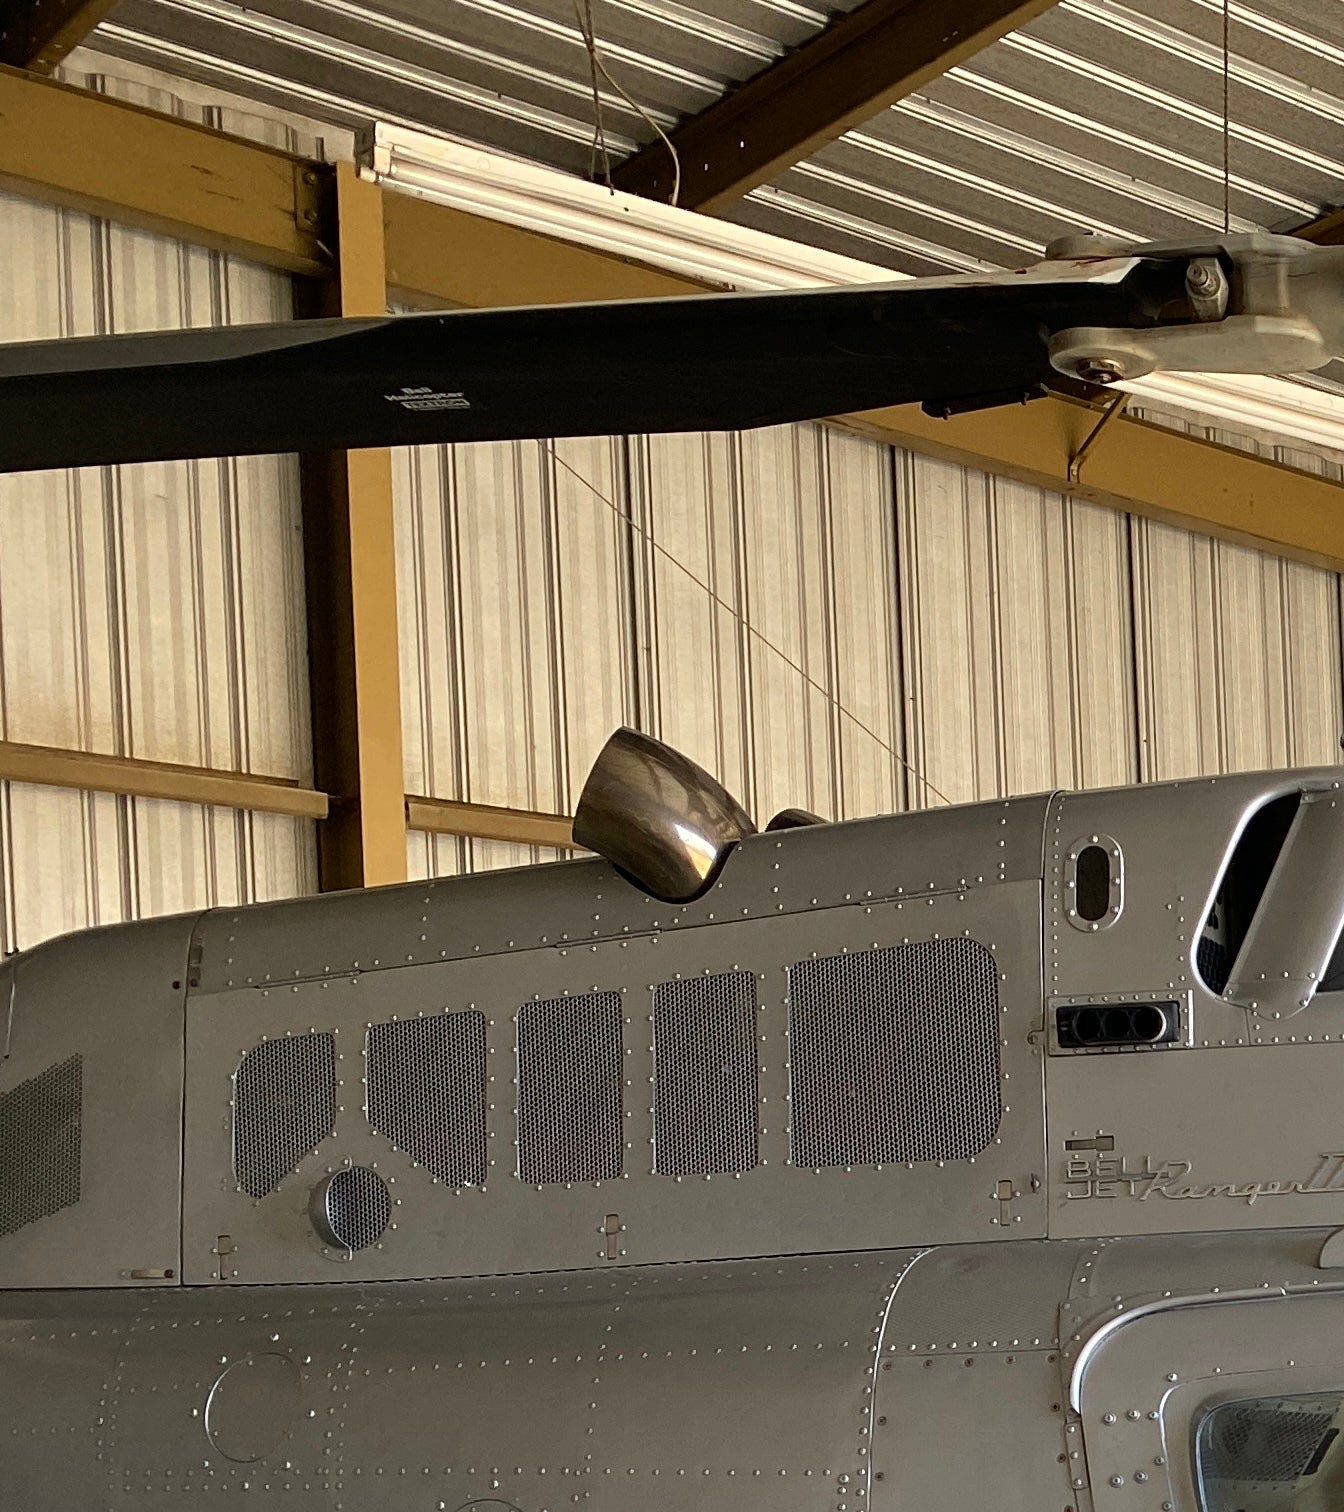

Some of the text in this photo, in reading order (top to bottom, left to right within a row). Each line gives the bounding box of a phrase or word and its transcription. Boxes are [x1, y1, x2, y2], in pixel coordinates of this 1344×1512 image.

[1066, 1178, 1140, 1200] JET
[1139, 1160, 1304, 1206] Ranger
[1067, 1155, 1171, 1179] BELL
